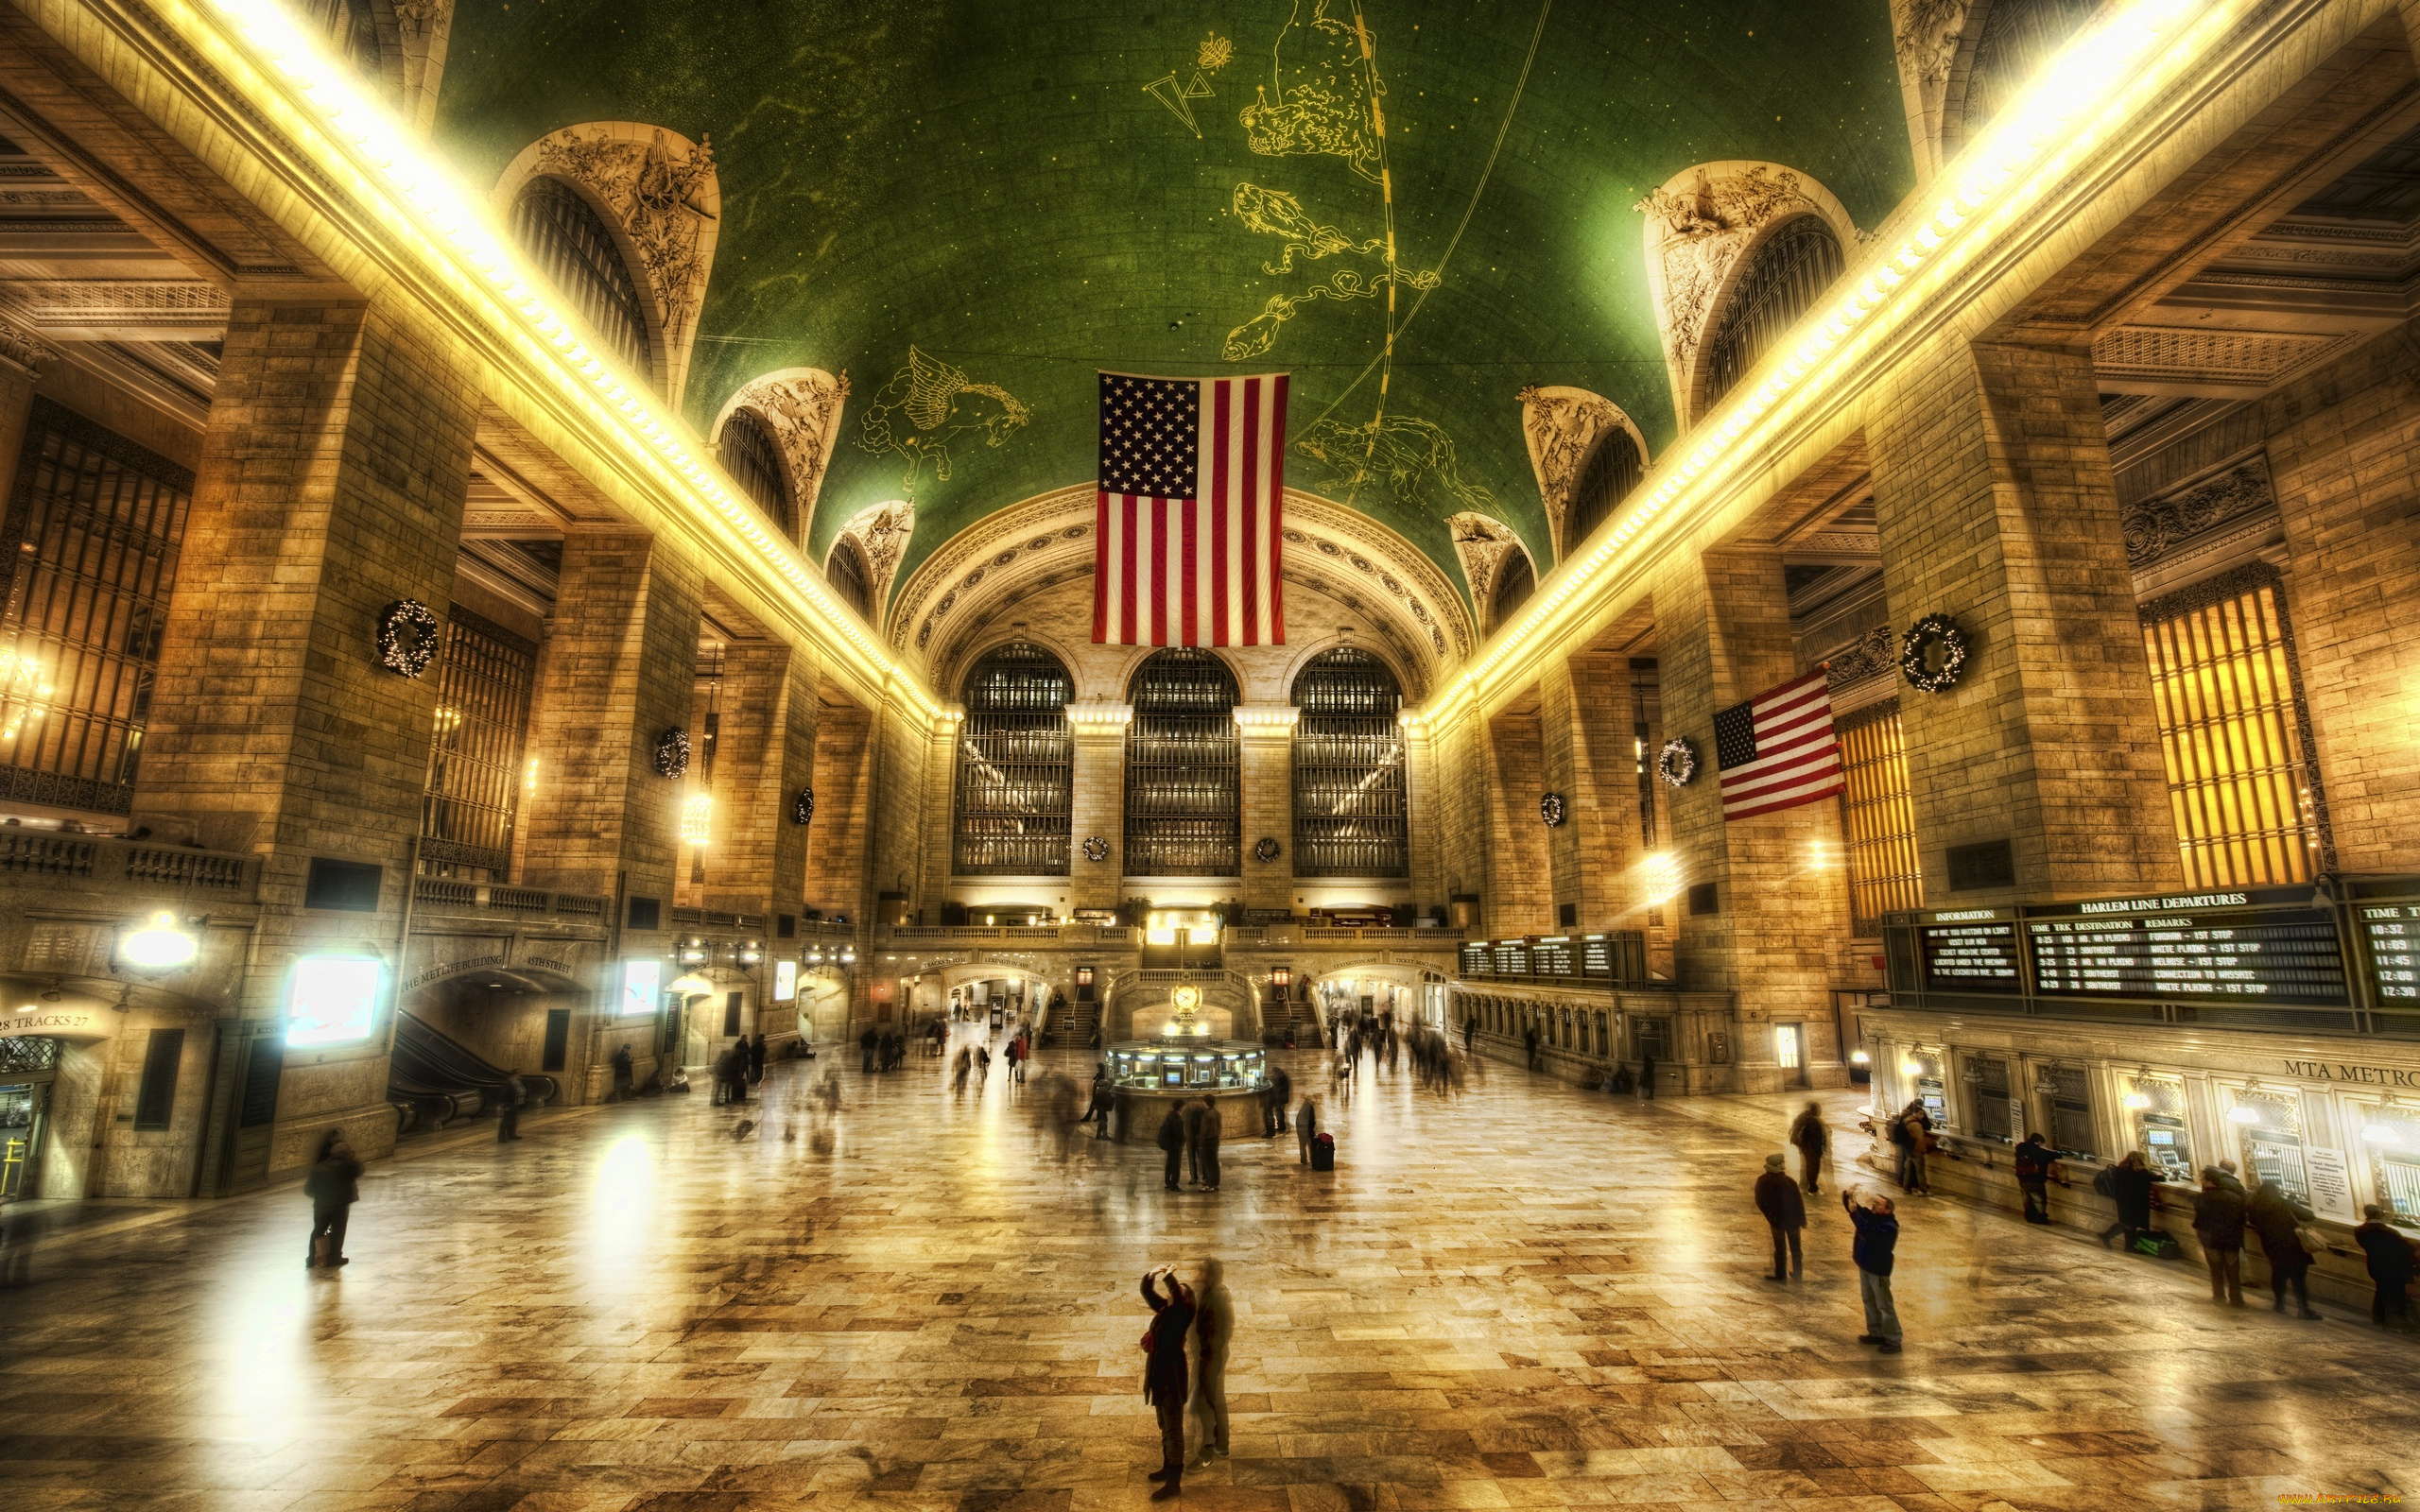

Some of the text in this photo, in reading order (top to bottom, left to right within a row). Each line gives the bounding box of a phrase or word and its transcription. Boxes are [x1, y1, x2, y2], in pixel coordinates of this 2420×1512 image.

[2082, 893, 2247, 913] HARLEM LINE DEPARTURES
[1936, 910, 1995, 921] INFORMATION
[2363, 907, 2400, 919] TIME
[2053, 923, 2072, 932] TRK
[2075, 920, 2133, 931] DESTINATION
[2144, 918, 2193, 928] REMARKS
[2371, 924, 2404, 935] 10:32
[2104, 934, 2131, 942] PLAINS
[2149, 932, 2182, 940] FORDHAM
[2193, 931, 2208, 939] 1ST
[2212, 930, 2233, 939] STOP
[2080, 946, 2116, 954] SOUTHEAST
[2151, 945, 2174, 954] WHITE
[2176, 945, 2206, 954] PLAINS
[2220, 944, 2235, 953] 1ST
[2238, 943, 2261, 952] STOP
[2373, 940, 2407, 950] 11:09
[527, 956, 571, 973] 45TH STREET
[924, 959, 945, 968] TRACKS
[984, 957, 1018, 966] LEXINGTON
[1333, 959, 1366, 970] LEXINGTON
[1416, 960, 1443, 971] MACHINES
[2108, 957, 2135, 966] PLAINS
[2152, 957, 2186, 966] MELROSE
[2198, 957, 2213, 966] 1ST
[2215, 957, 2238, 966] STOP
[2377, 955, 2411, 965] 11:45
[421, 963, 460, 984] METLIFE
[462, 955, 502, 970] BUILDING
[2083, 970, 2119, 978] SOUTHEAST
[2154, 970, 2202, 979] CONNECTION
[2204, 971, 2216, 979] TO
[2218, 971, 2256, 979] WASSAIC
[2379, 971, 2413, 981] 12:08
[2085, 982, 2121, 990] SOUTHEAST
[2156, 983, 2181, 991] WHITE
[2182, 983, 2213, 992] PLAINS
[2225, 984, 2241, 992] 1ST
[2244, 985, 2268, 993] STOP
[2382, 987, 2416, 997] 12:30
[15, 1016, 71, 1028] TRACKS
[74, 1017, 88, 1026] 27
[2284, 1060, 2332, 1078] MTA
